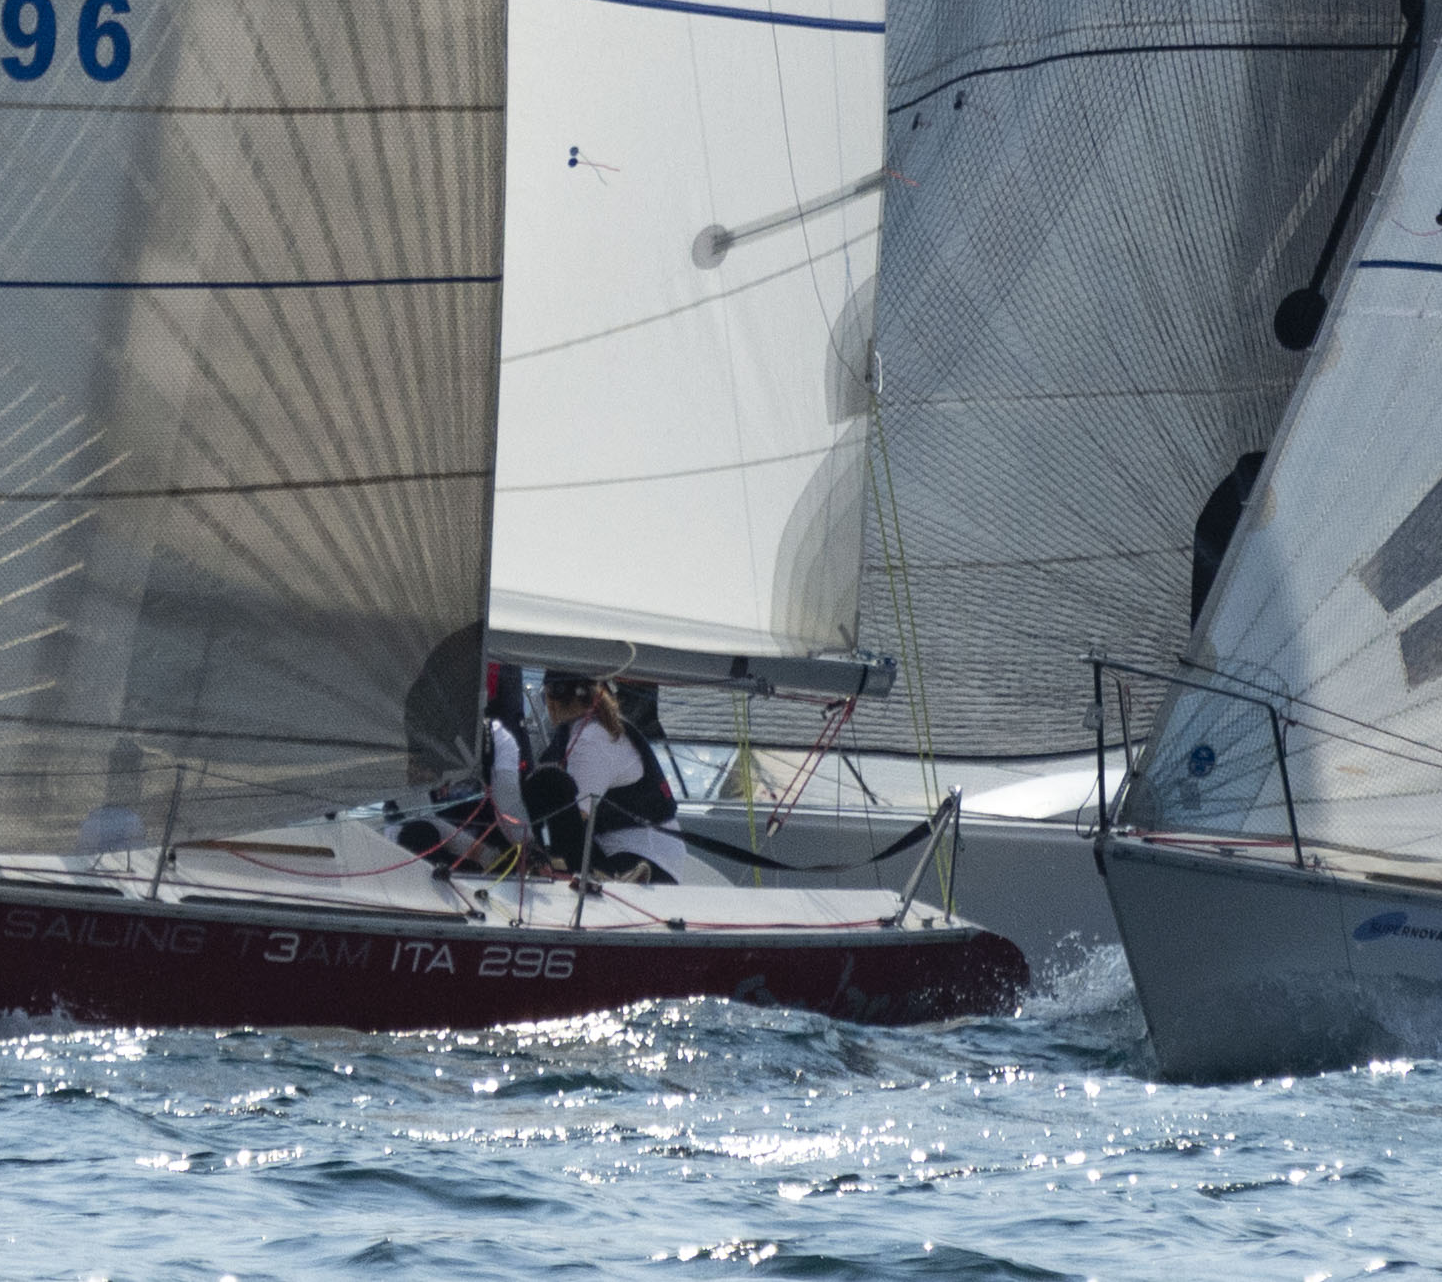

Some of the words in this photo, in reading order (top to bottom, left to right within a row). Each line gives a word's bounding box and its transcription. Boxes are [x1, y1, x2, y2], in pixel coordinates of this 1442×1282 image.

[3, 908, 208, 955] SAILING
[391, 941, 454, 975] ITA
[477, 946, 577, 980] 296
